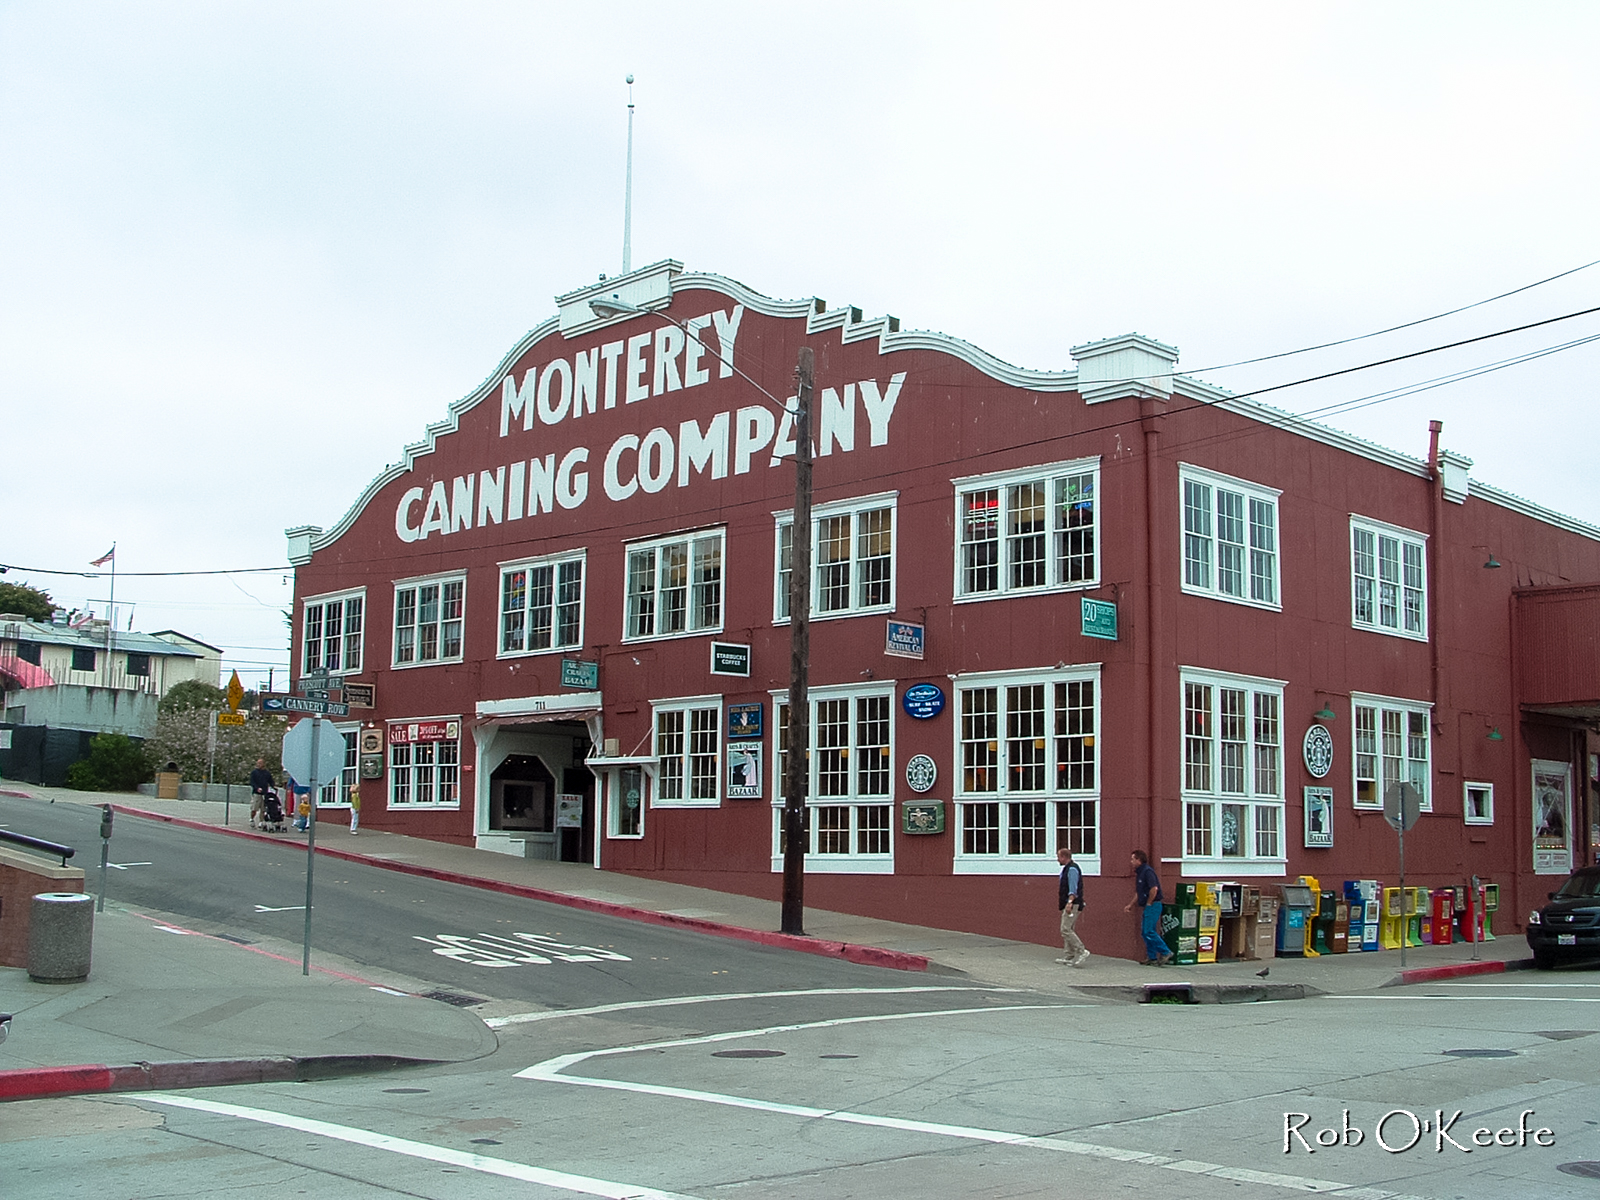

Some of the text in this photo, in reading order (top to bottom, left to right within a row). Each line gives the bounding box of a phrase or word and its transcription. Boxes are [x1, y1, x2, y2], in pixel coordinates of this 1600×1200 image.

[499, 305, 744, 438] MONTEREY
[395, 372, 907, 543] CANNING COMPANY
[1084, 603, 1096, 621] 20
[1097, 605, 1114, 616] SHOPS
[892, 633, 919, 644] AMERICAN
[888, 641, 911, 651] REVIVAL
[716, 653, 746, 661] STARBUCKS
[298, 678, 326, 690] PRESCOTT
[565, 677, 593, 685] BAZAAR
[286, 699, 346, 715] CANNERY ROW
[535, 701, 546, 710] 711
[391, 730, 407, 742] SALE
[908, 757, 932, 772] STARBUCKS
[1309, 761, 1328, 775] COFFEE
[911, 780, 929, 790] COFFEE
[729, 787, 759, 796] BAZAAR
[1309, 834, 1332, 843] BAZAAR
